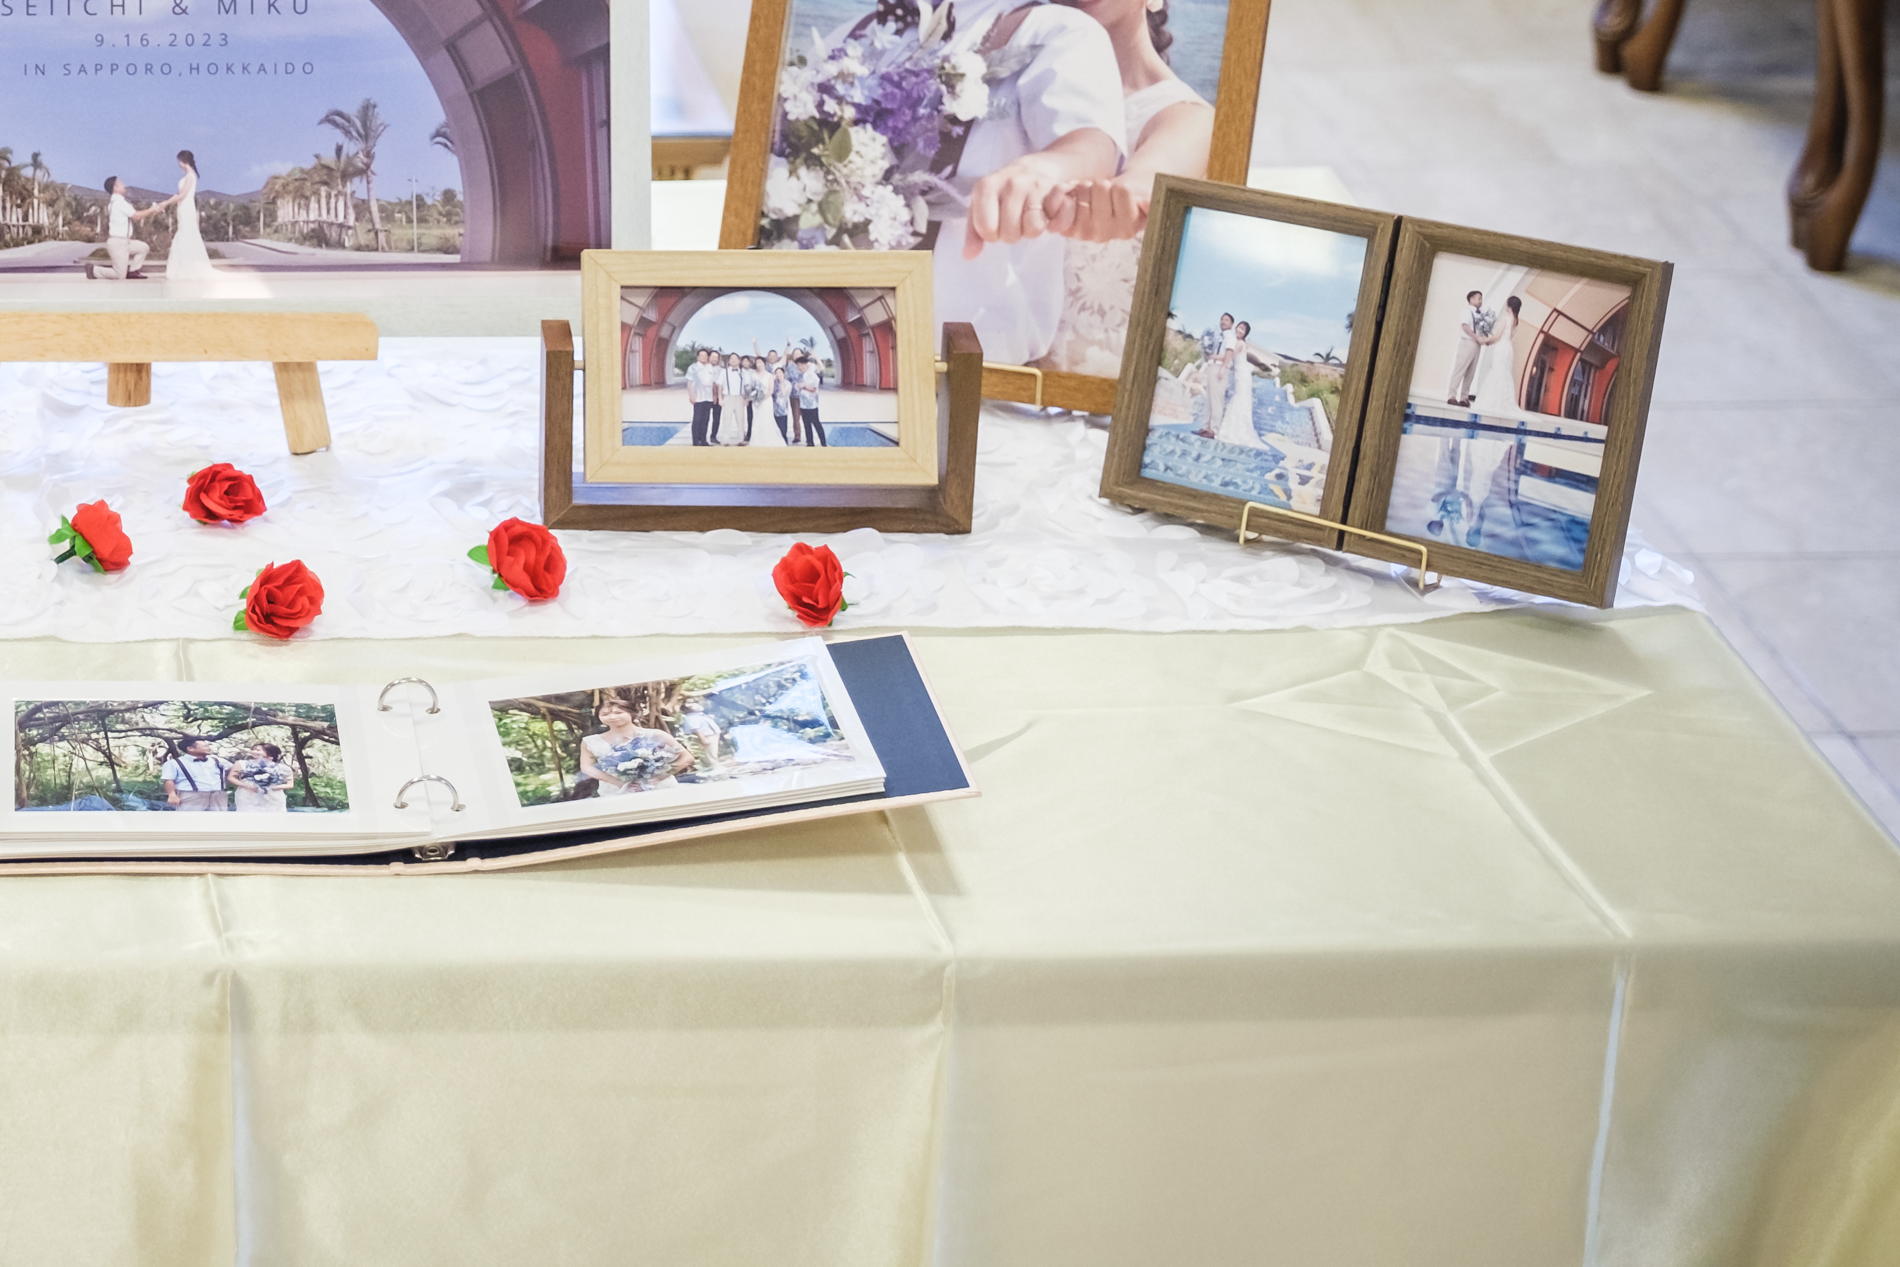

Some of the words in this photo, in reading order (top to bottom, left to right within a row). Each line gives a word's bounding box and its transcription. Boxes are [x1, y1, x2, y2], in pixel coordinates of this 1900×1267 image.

[94, 33, 229, 47] 9.16.2023
[24, 63, 46, 76] IN
[63, 62, 315, 77] SAPPORO,HOKKAIDO
